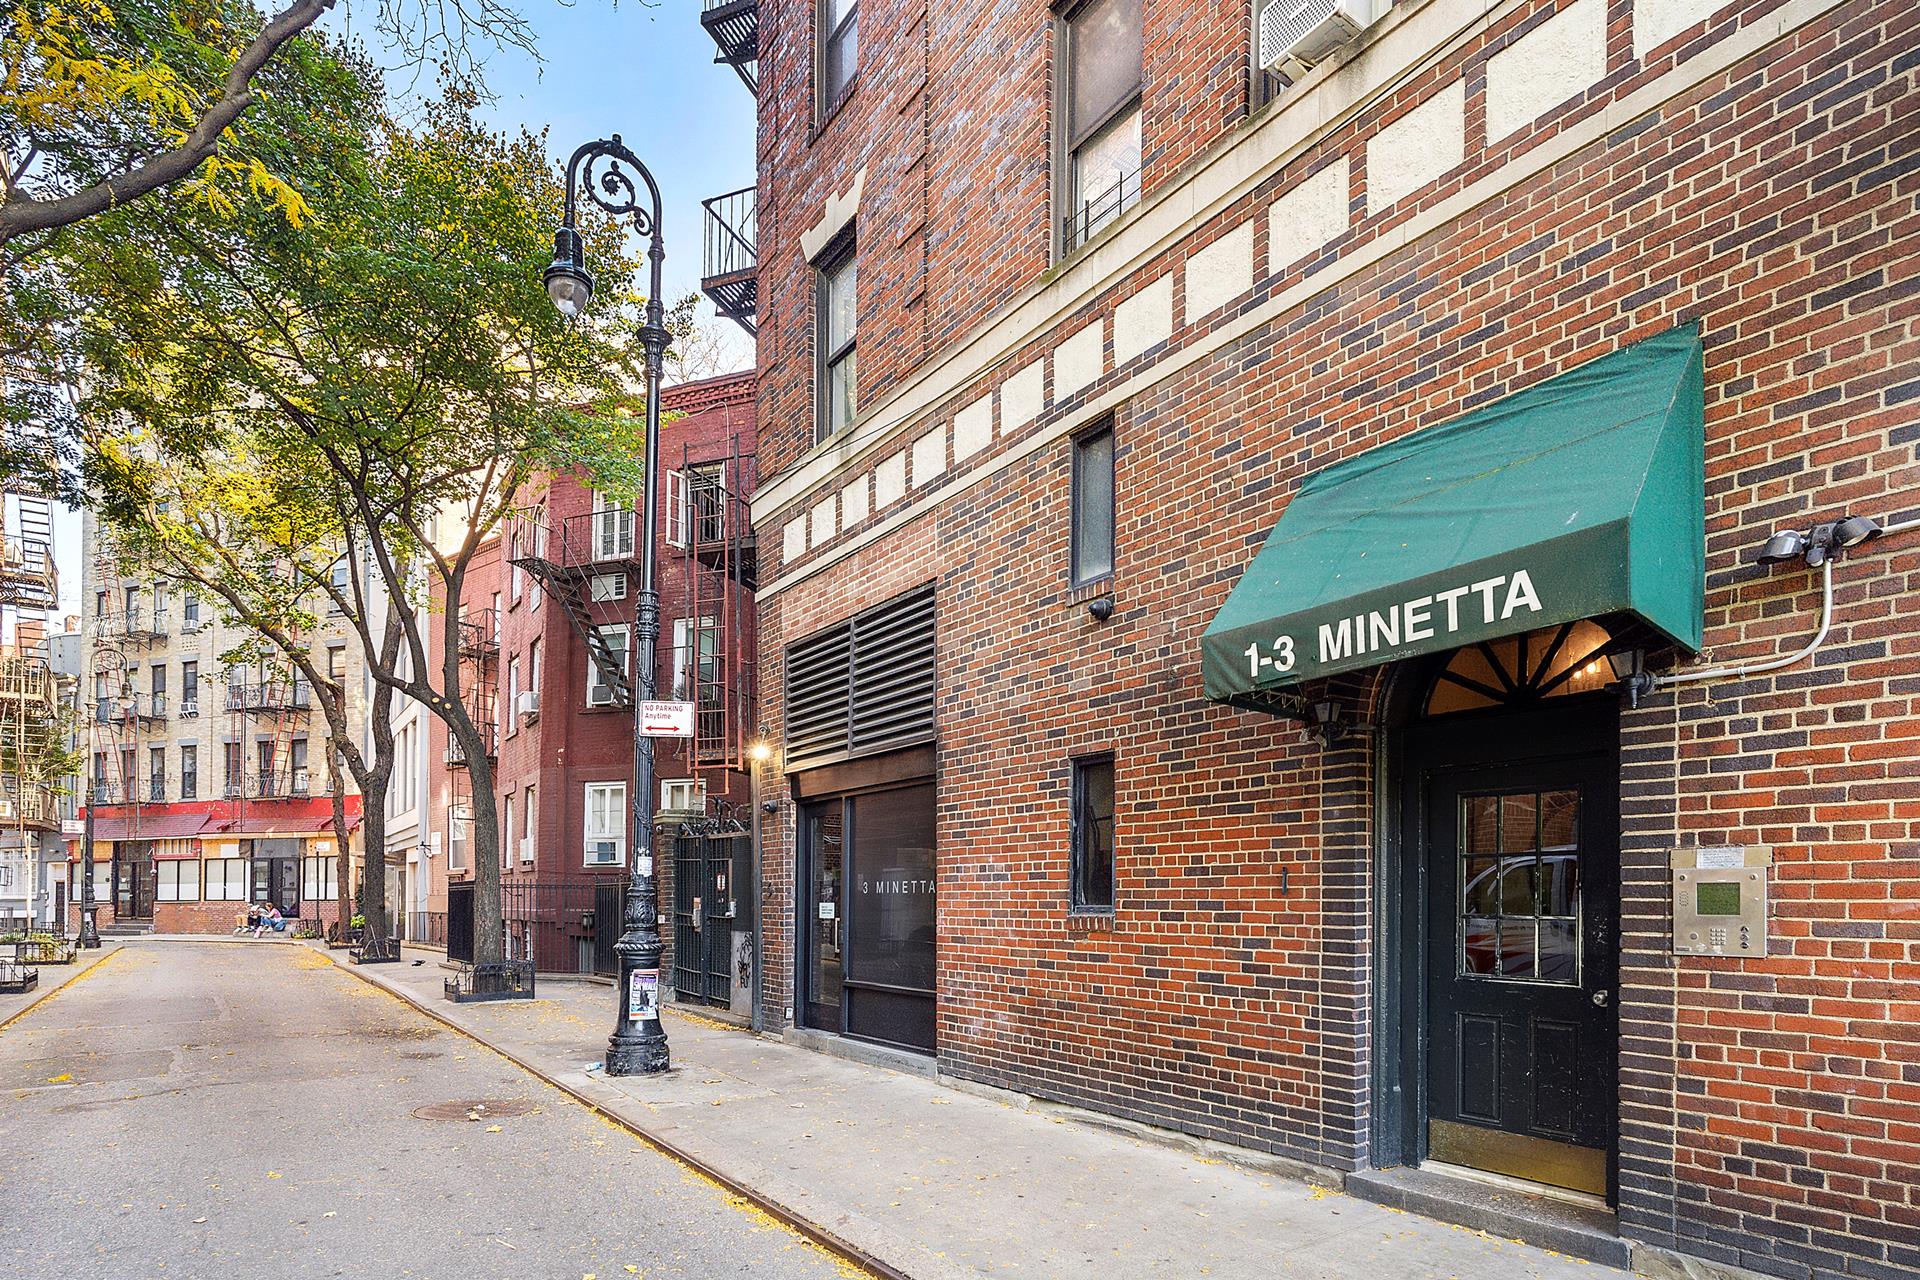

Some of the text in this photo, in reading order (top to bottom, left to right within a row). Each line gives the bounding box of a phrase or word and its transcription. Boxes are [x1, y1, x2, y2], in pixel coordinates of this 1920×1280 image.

[1244, 569, 1543, 678] 1-3 MINETTA
[863, 880, 936, 894] 3 MINETTA
